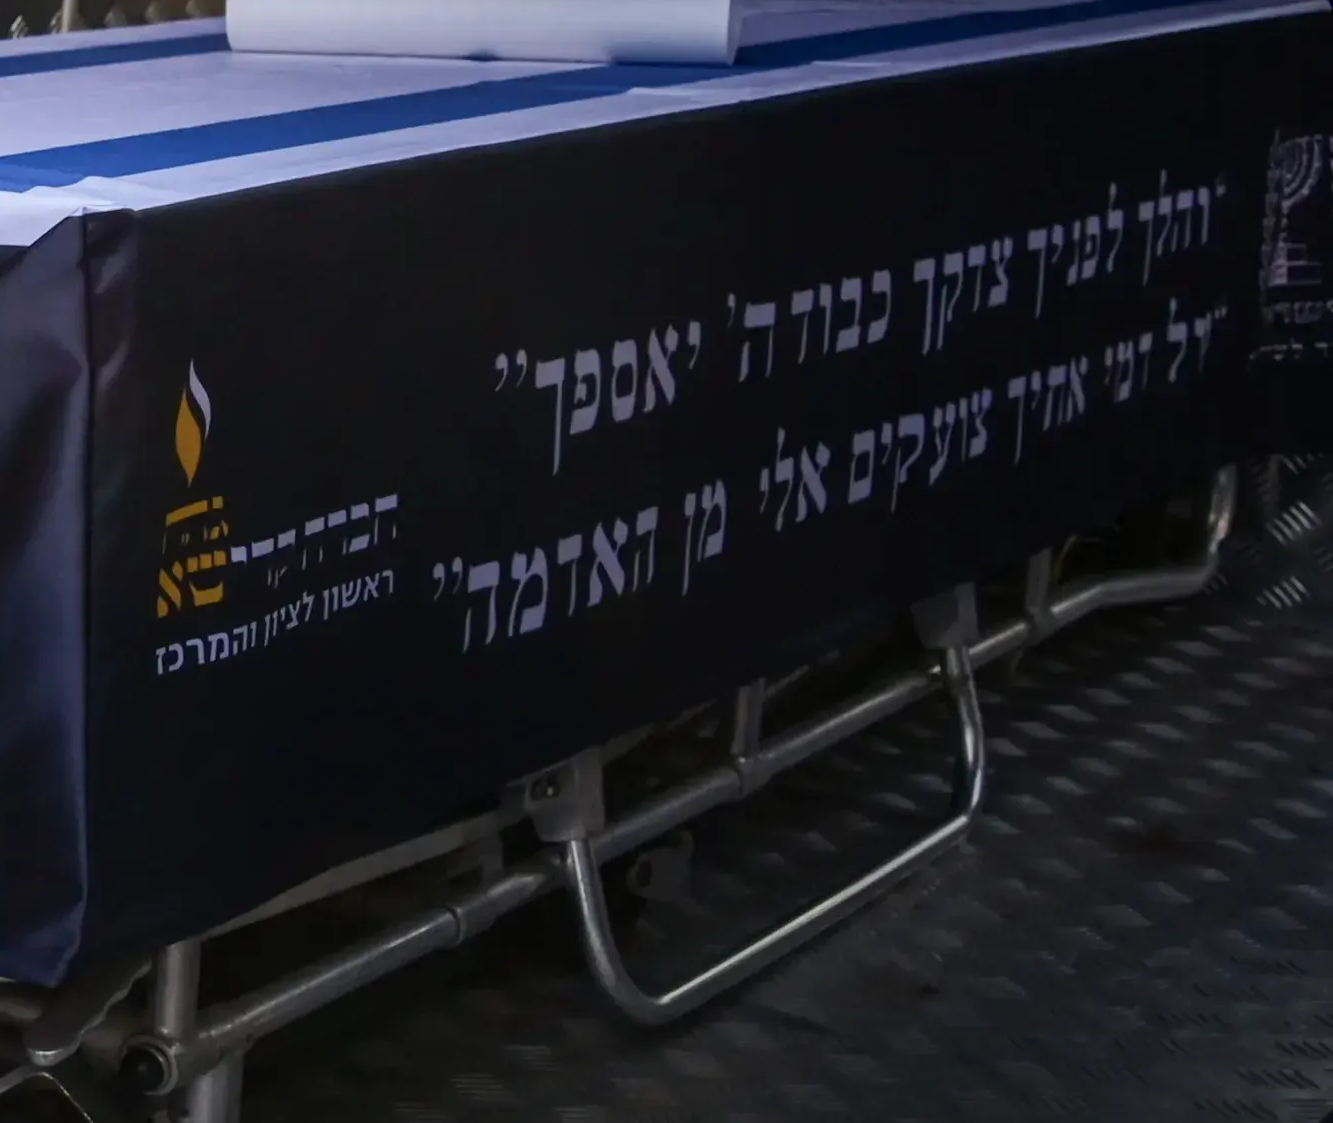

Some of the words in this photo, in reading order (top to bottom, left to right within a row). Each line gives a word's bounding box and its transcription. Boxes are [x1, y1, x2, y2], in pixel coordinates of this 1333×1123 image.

[913, 235, 1015, 357] צדקך
[1027, 180, 1124, 320] לפניך
[790, 268, 893, 365] כבוד
[1008, 355, 1090, 463] אחיך
[1104, 332, 1154, 405] דמי
[759, 427, 833, 533] אלי
[846, 387, 994, 513] צועקים
[301, 493, 400, 572] חברה
[681, 479, 728, 596] מן
[263, 589, 316, 648] לציון
[321, 567, 396, 623] ראשון
[154, 620, 258, 677] והמרכז
